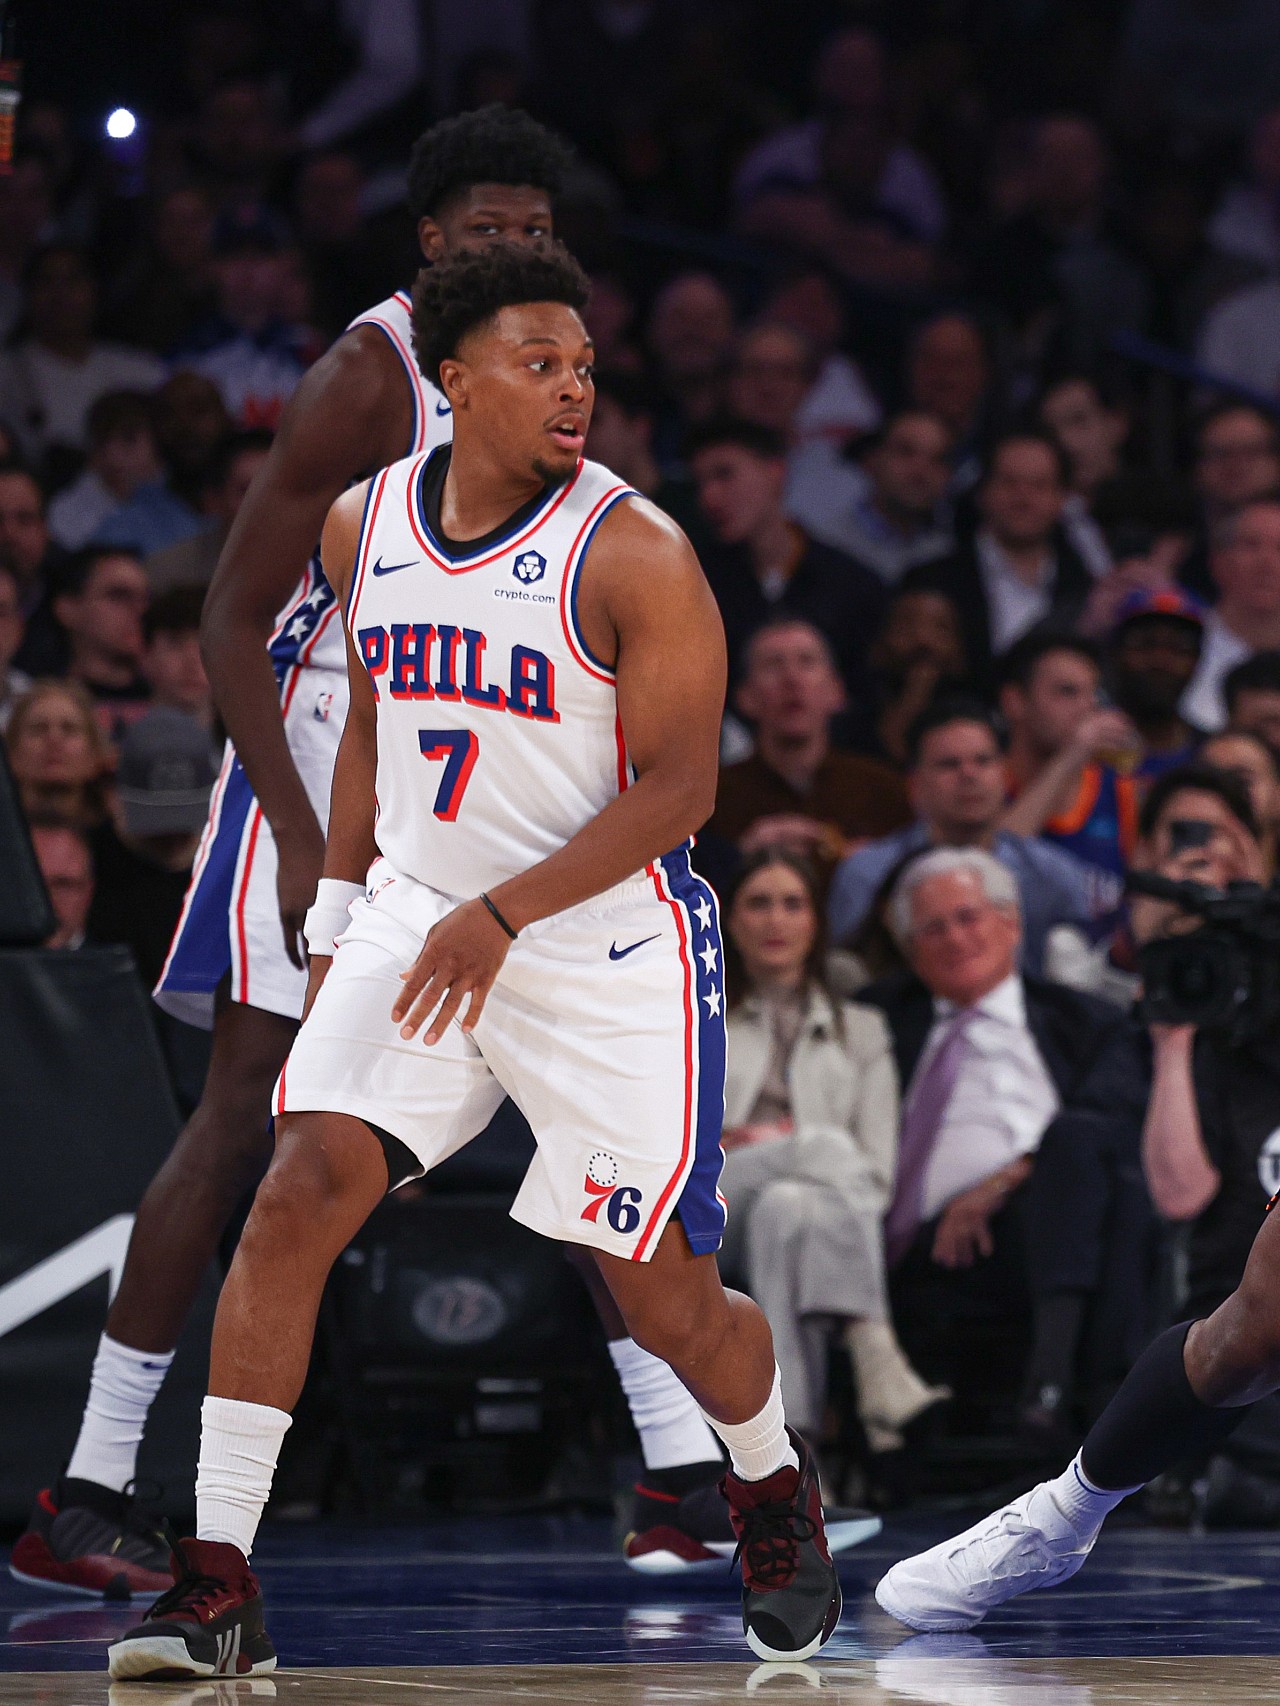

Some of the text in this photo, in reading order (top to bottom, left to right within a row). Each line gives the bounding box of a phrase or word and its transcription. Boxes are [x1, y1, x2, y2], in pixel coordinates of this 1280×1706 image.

[494, 589, 556, 604] crypto.com
[358, 623, 561, 724] PHILA
[418, 729, 480, 822] 7
[580, 1172, 643, 1234] 76
